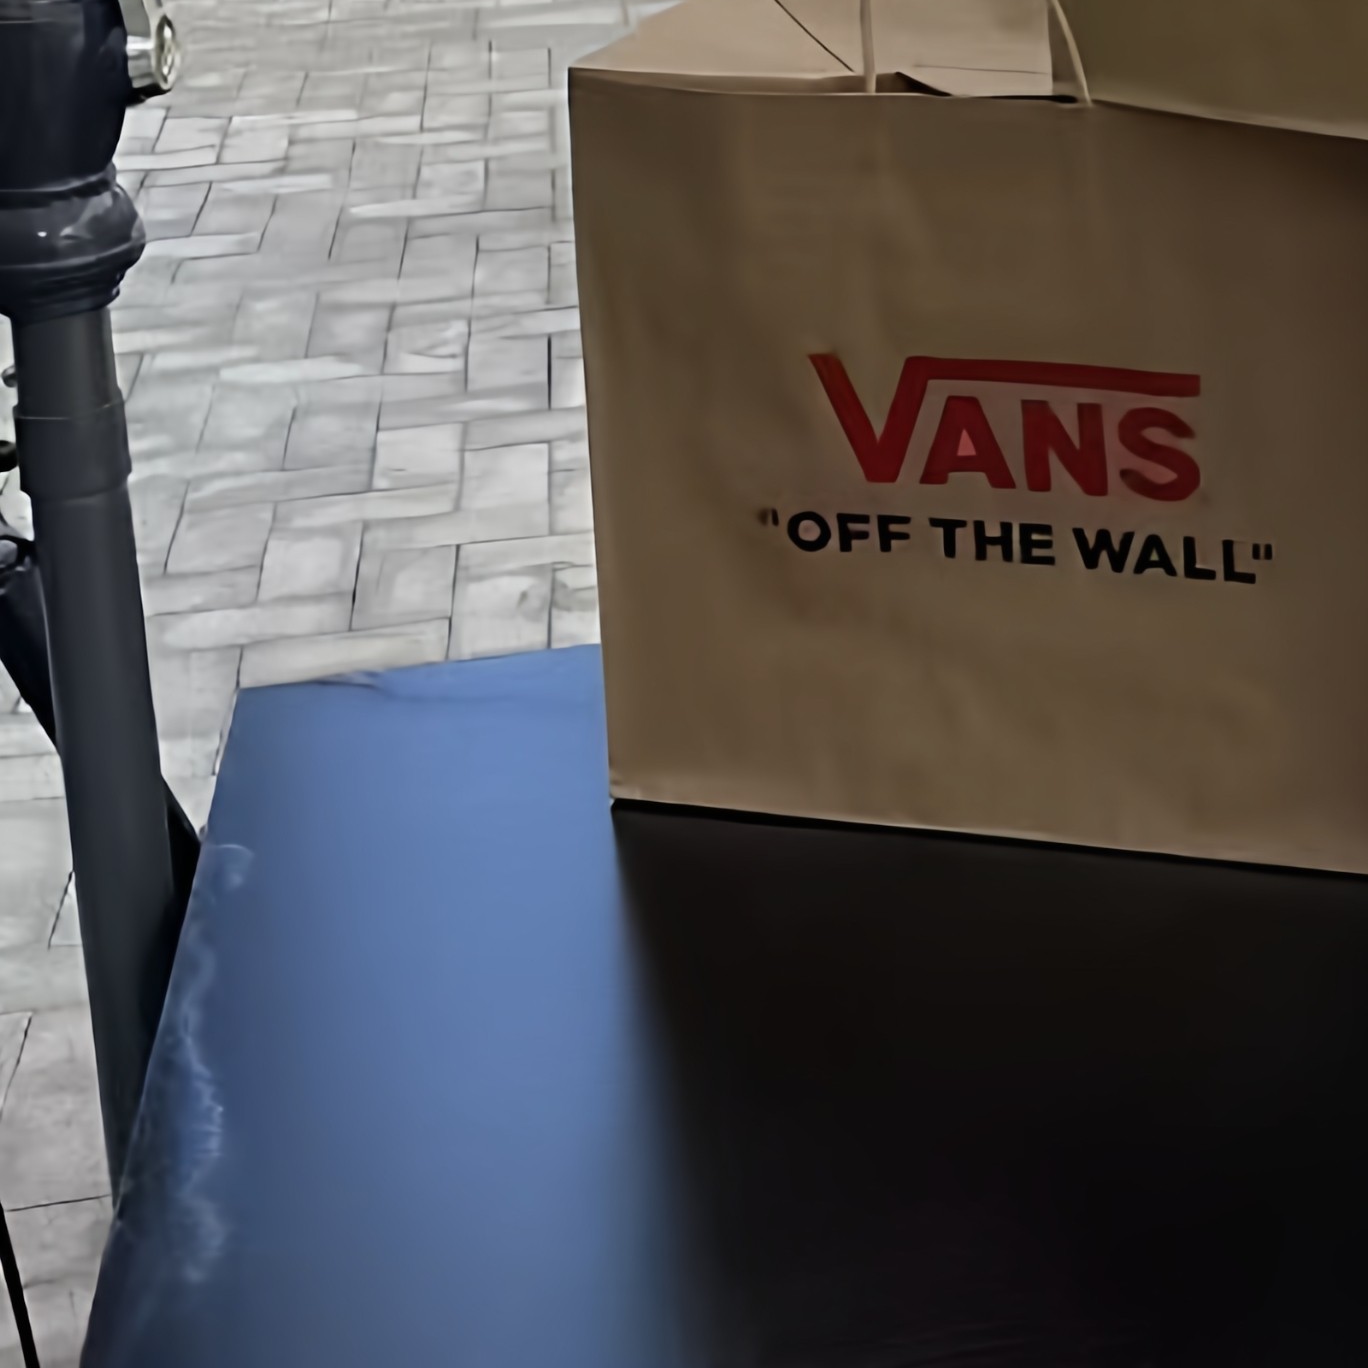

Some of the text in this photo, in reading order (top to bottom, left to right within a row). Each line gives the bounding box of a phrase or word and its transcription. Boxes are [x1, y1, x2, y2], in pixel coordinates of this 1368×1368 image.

[807, 352, 1201, 501] VANS
[757, 508, 1274, 584] "OFF THE WALL"
